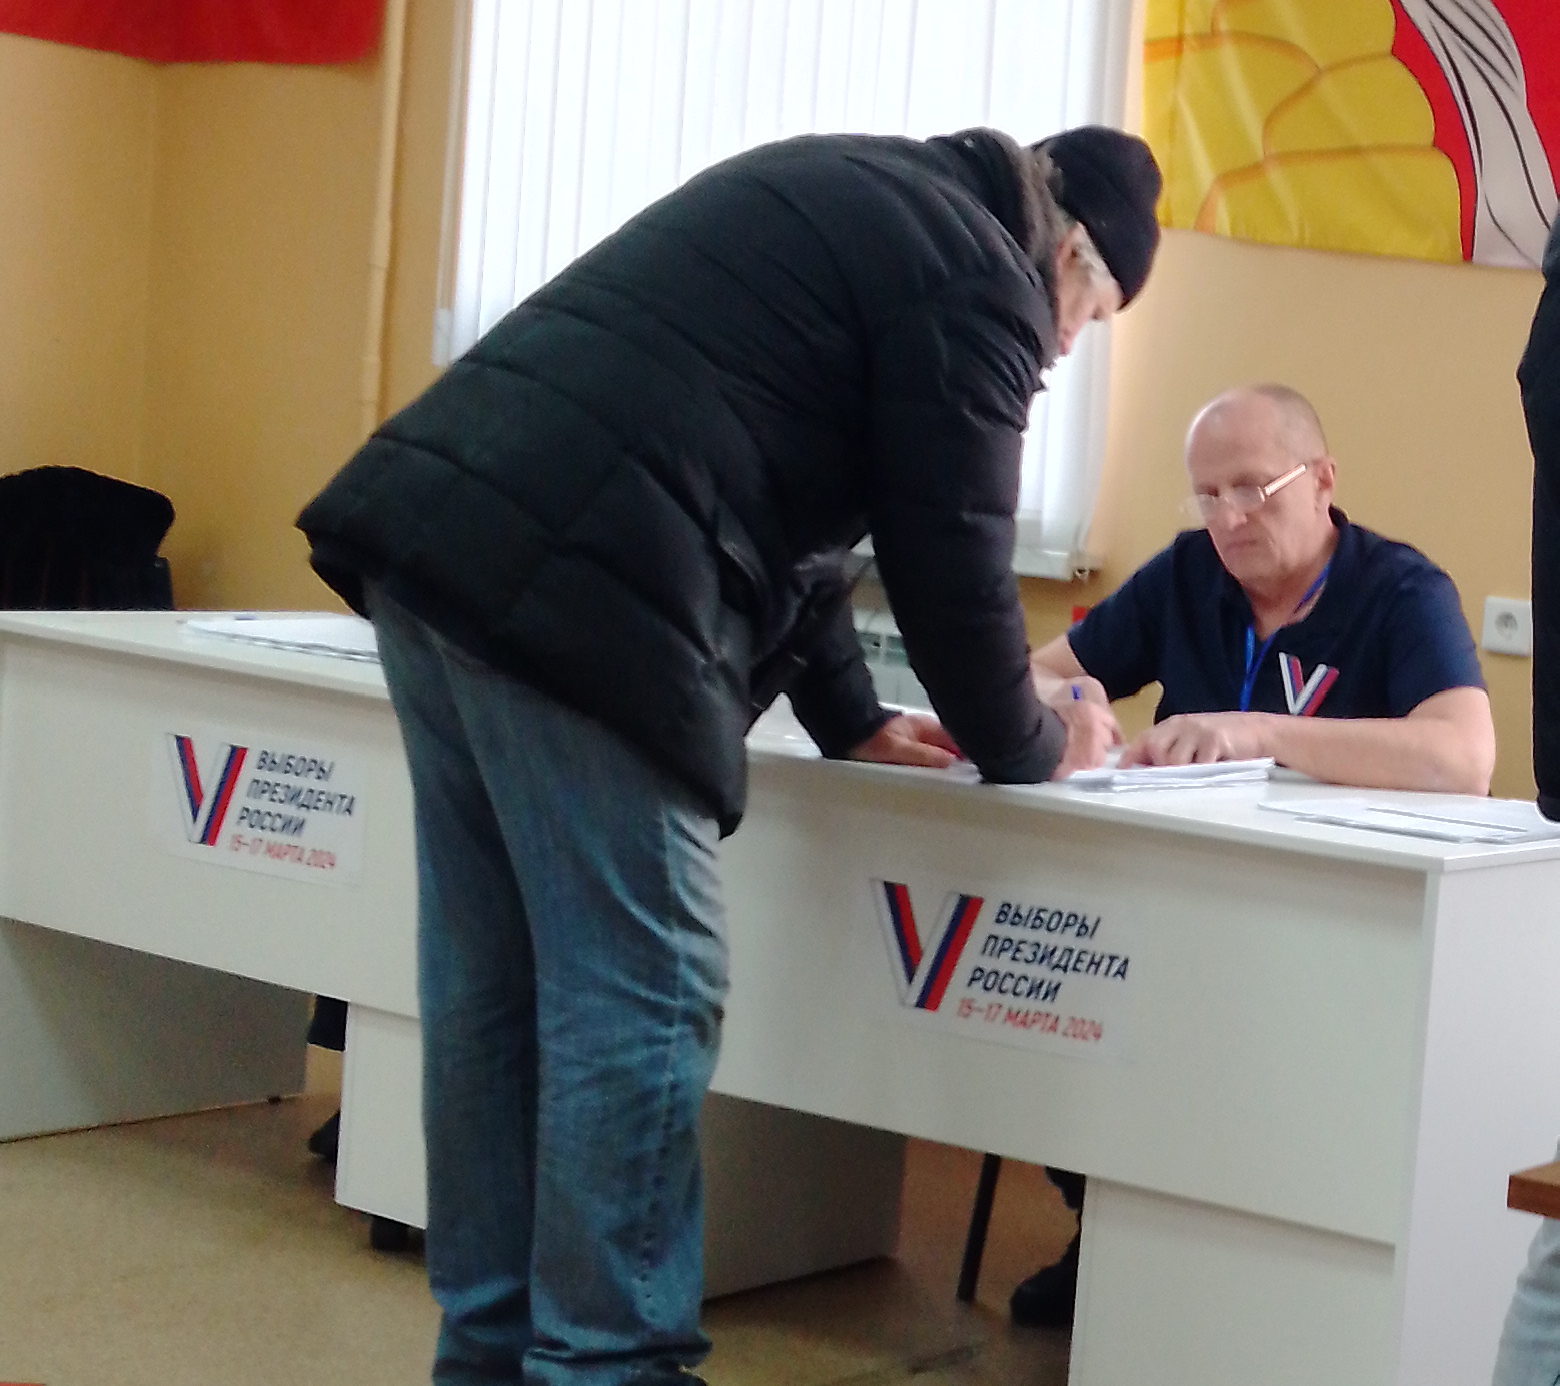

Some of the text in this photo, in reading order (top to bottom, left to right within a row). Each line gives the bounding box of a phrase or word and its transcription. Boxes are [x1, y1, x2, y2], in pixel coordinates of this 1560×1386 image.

[256, 750, 335, 781] ВЫБОРЫ
[247, 778, 355, 816] ПРЕЗИДЕНТА
[237, 806, 306, 837] РОССИИ
[995, 901, 1101, 938] ВЫБОРЫ
[982, 934, 1130, 980] ПРЕЗИДЕНТА
[967, 965, 1061, 1002] РОССИИ
[1005, 1006, 1060, 1035] МАРТА
[1062, 1015, 1103, 1041] 2024
